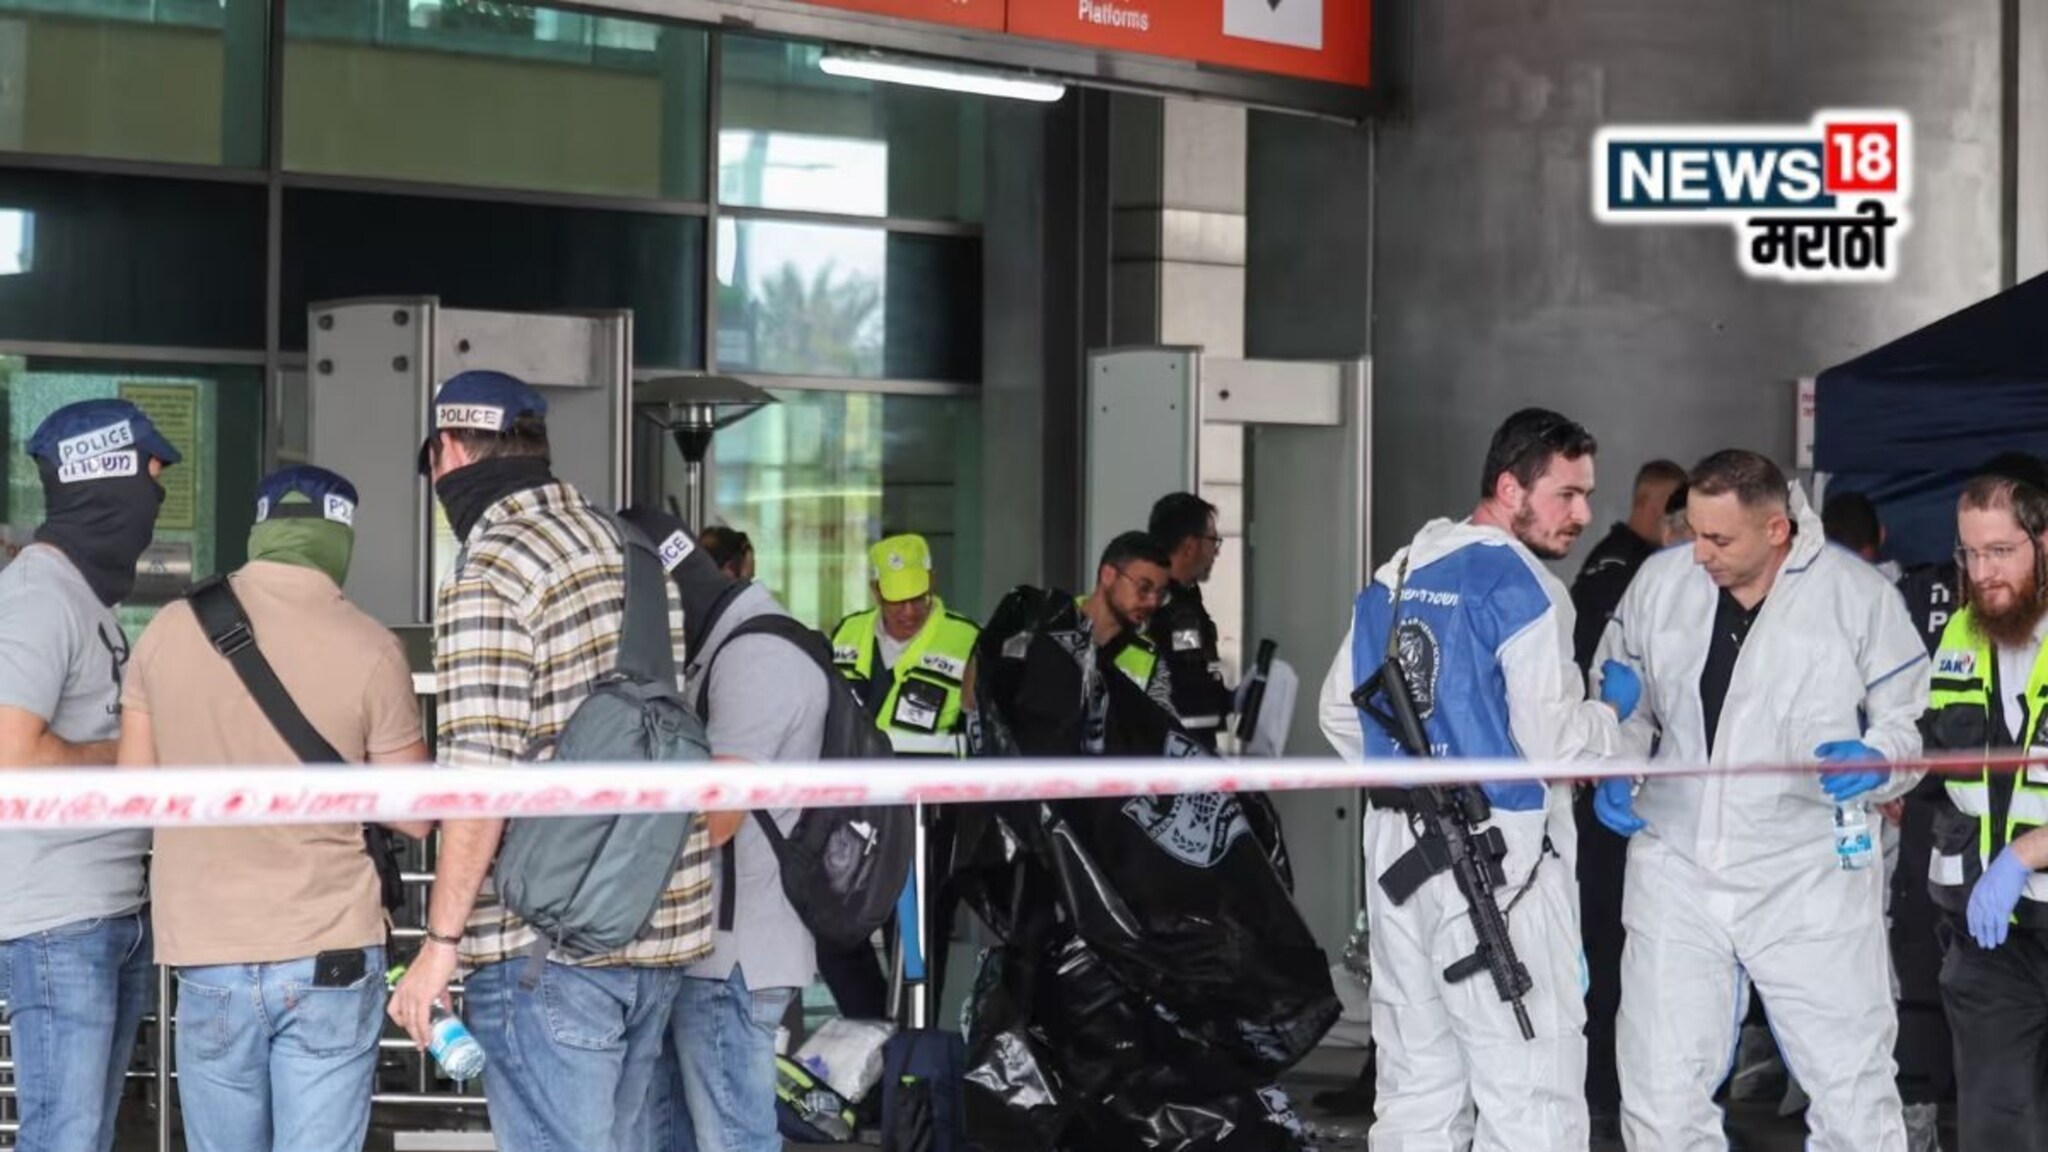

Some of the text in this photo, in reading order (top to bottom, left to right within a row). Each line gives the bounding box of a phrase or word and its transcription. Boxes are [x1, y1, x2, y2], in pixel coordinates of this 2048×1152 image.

[1078, 0, 1149, 31] Platforms
[440, 408, 498, 425] POLICE
[63, 426, 130, 460] POLICE
